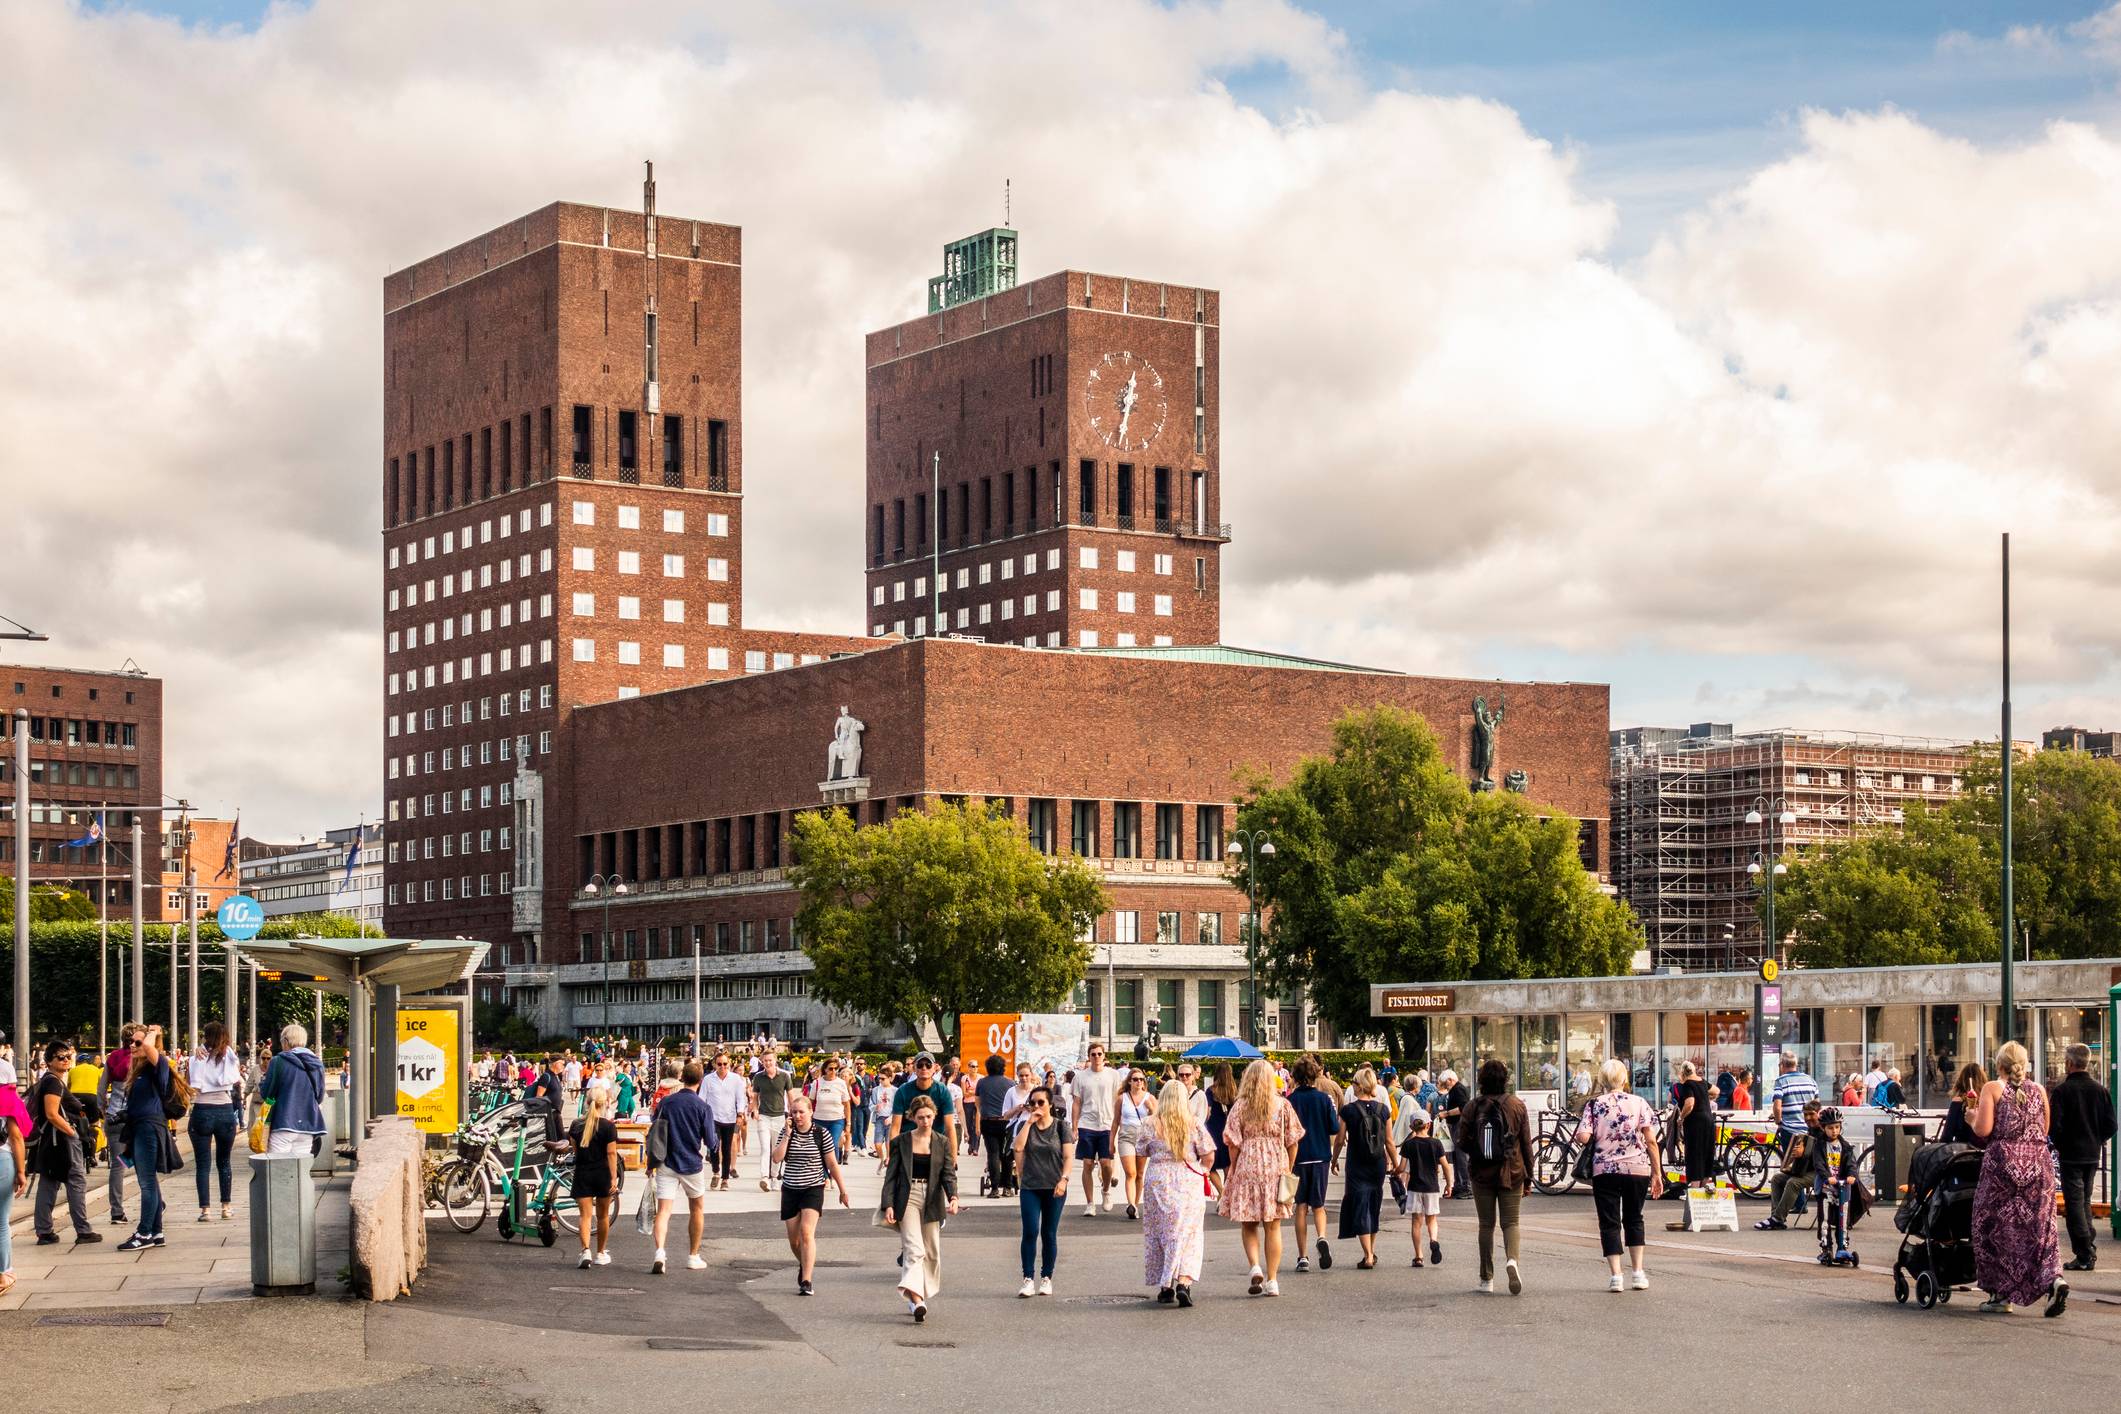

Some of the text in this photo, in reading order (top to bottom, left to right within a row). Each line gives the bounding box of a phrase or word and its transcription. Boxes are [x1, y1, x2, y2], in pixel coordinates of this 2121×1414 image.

[225, 902, 249, 922] 10
[1767, 963, 1775, 976] D
[1387, 995, 1449, 1008] FISKETORGET
[406, 1016, 428, 1031] ice
[987, 1023, 1014, 1054] 06
[397, 1063, 436, 1081] 1 kr
[401, 1104, 415, 1112] GB
